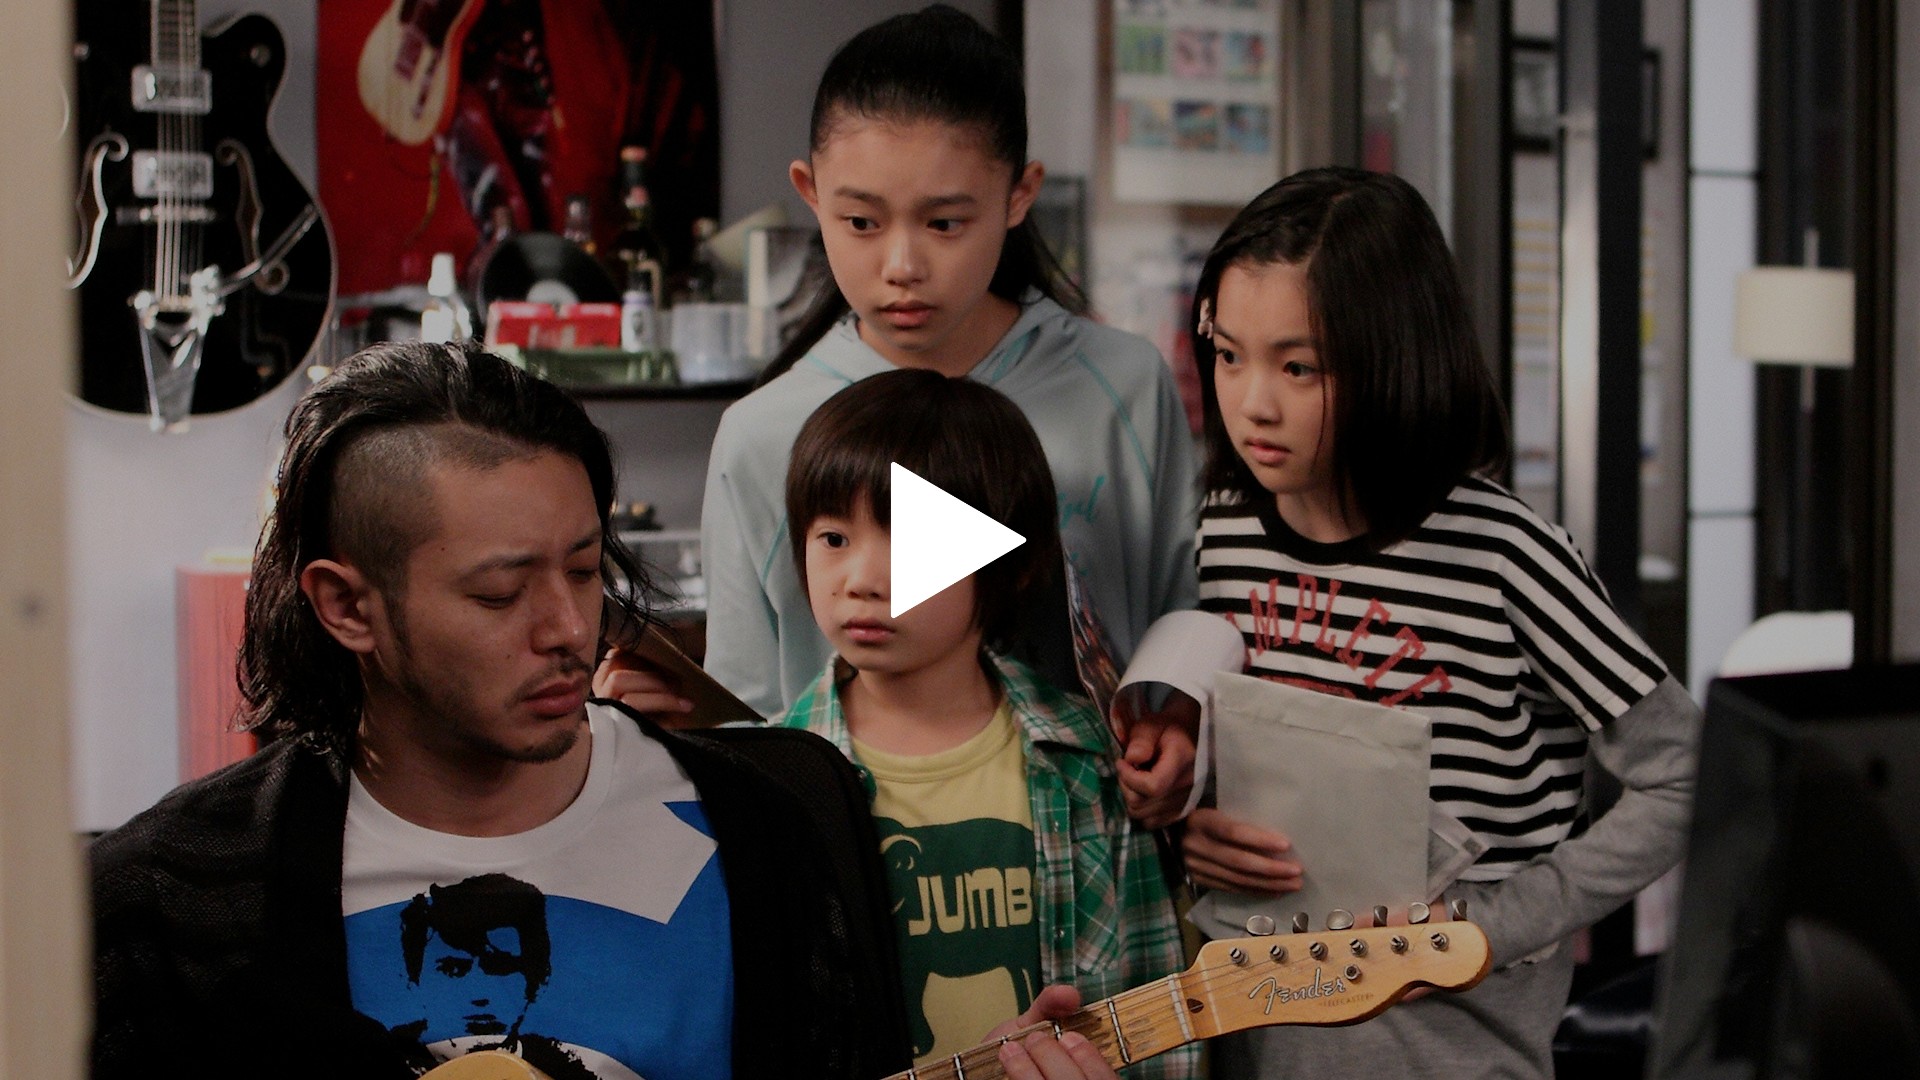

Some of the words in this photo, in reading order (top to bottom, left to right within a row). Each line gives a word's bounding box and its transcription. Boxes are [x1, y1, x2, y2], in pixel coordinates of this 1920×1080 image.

[1225, 574, 1453, 709] MPLETE
[908, 866, 1037, 936] JUMB
[1249, 966, 1346, 1015] Fender
